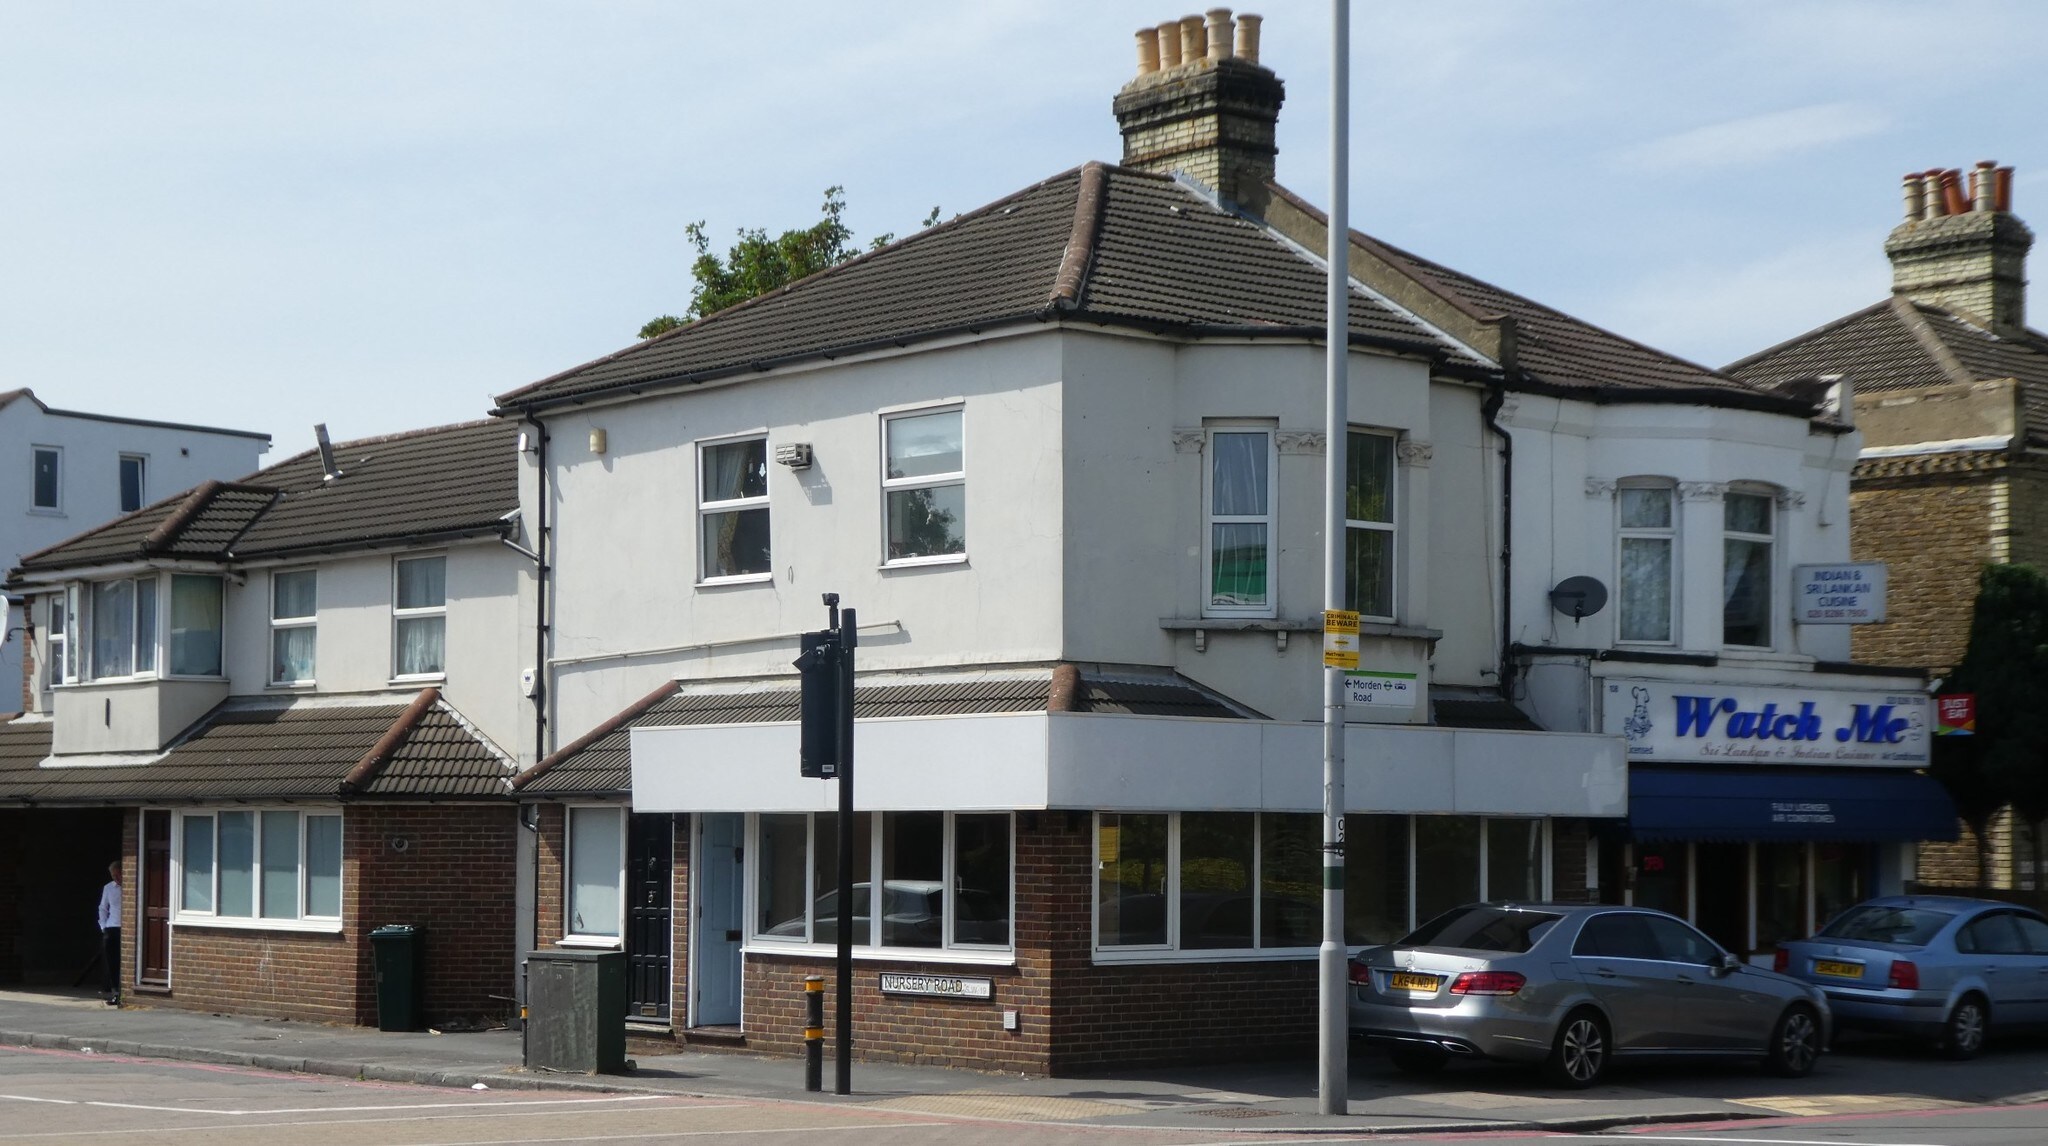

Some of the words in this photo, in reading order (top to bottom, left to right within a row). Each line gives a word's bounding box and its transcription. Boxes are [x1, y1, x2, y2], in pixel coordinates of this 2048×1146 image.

[1814, 570, 1852, 581] INDIAN
[1853, 570, 1862, 581] &
[1806, 583, 1822, 594] SRI
[1823, 583, 1871, 594] LANKAN
[1818, 596, 1857, 607] CUISINE
[1326, 613, 1359, 621] CRIMINALS
[1326, 619, 1358, 628] BEWARE
[1353, 680, 1382, 691] Morden
[1353, 692, 1373, 702] Road
[1942, 698, 1969, 710] JUST
[1947, 708, 1969, 719] EAT
[1672, 695, 1823, 742] Watch
[1836, 703, 1910, 744] Me
[1701, 742, 1721, 756] Sri
[1723, 743, 1770, 757] Lankan
[1790, 745, 1831, 759] Indian
[1772, 803, 1794, 812] FULLY
[1796, 803, 1831, 812] LICENSED
[1772, 813, 1786, 823] AIR
[1787, 814, 1835, 823] CONDITIONED
[884, 976, 931, 992] NURSERY
[934, 978, 963, 993] ROAD
[1392, 974, 1415, 987] LK64
[1417, 977, 1436, 988] NDY
